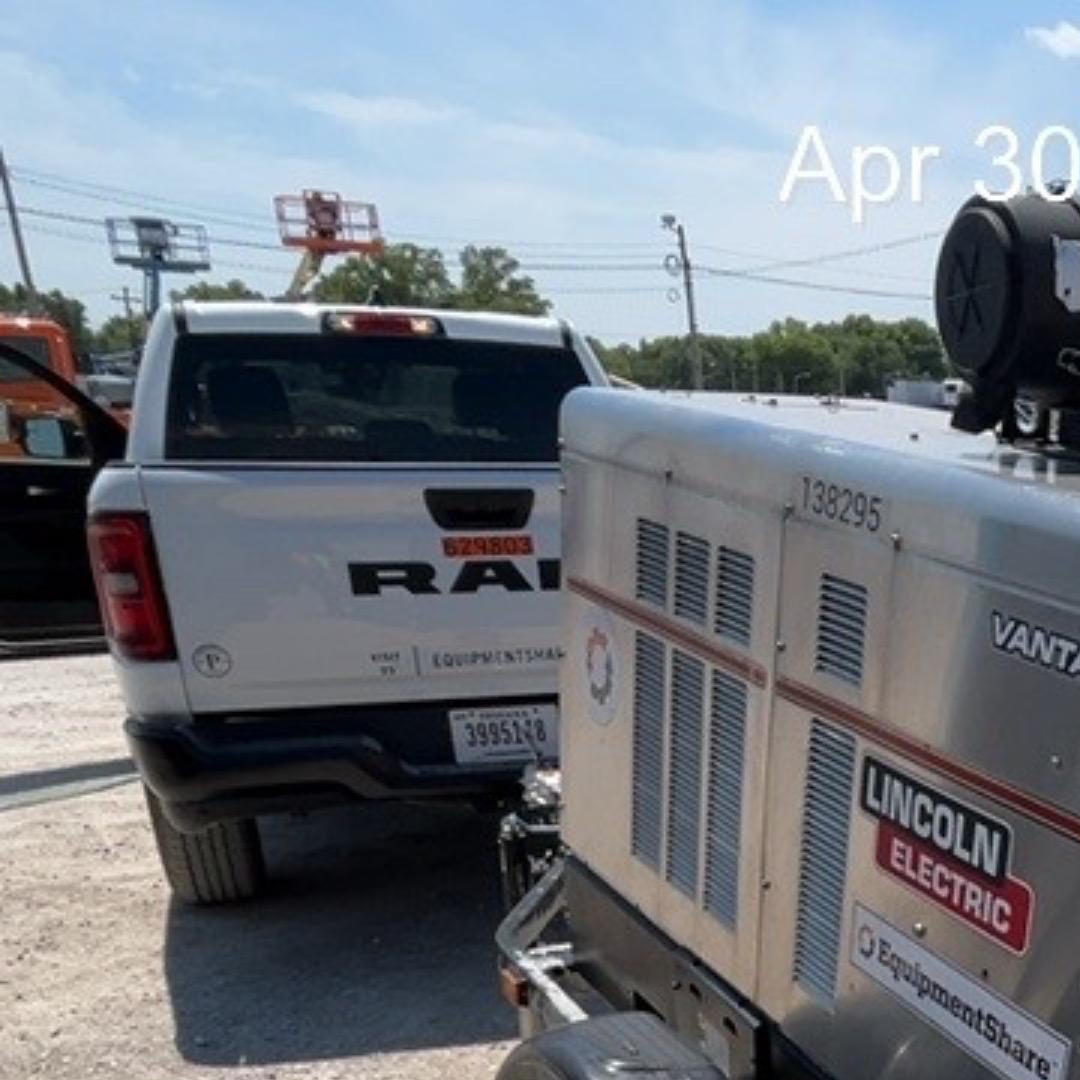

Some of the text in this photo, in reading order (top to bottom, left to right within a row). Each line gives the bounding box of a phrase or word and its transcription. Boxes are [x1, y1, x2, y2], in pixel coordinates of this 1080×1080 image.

[801, 476, 883, 532] 138295
[865, 764, 1001, 877] LINCOLN
[889, 835, 1013, 935] ELECTRIC
